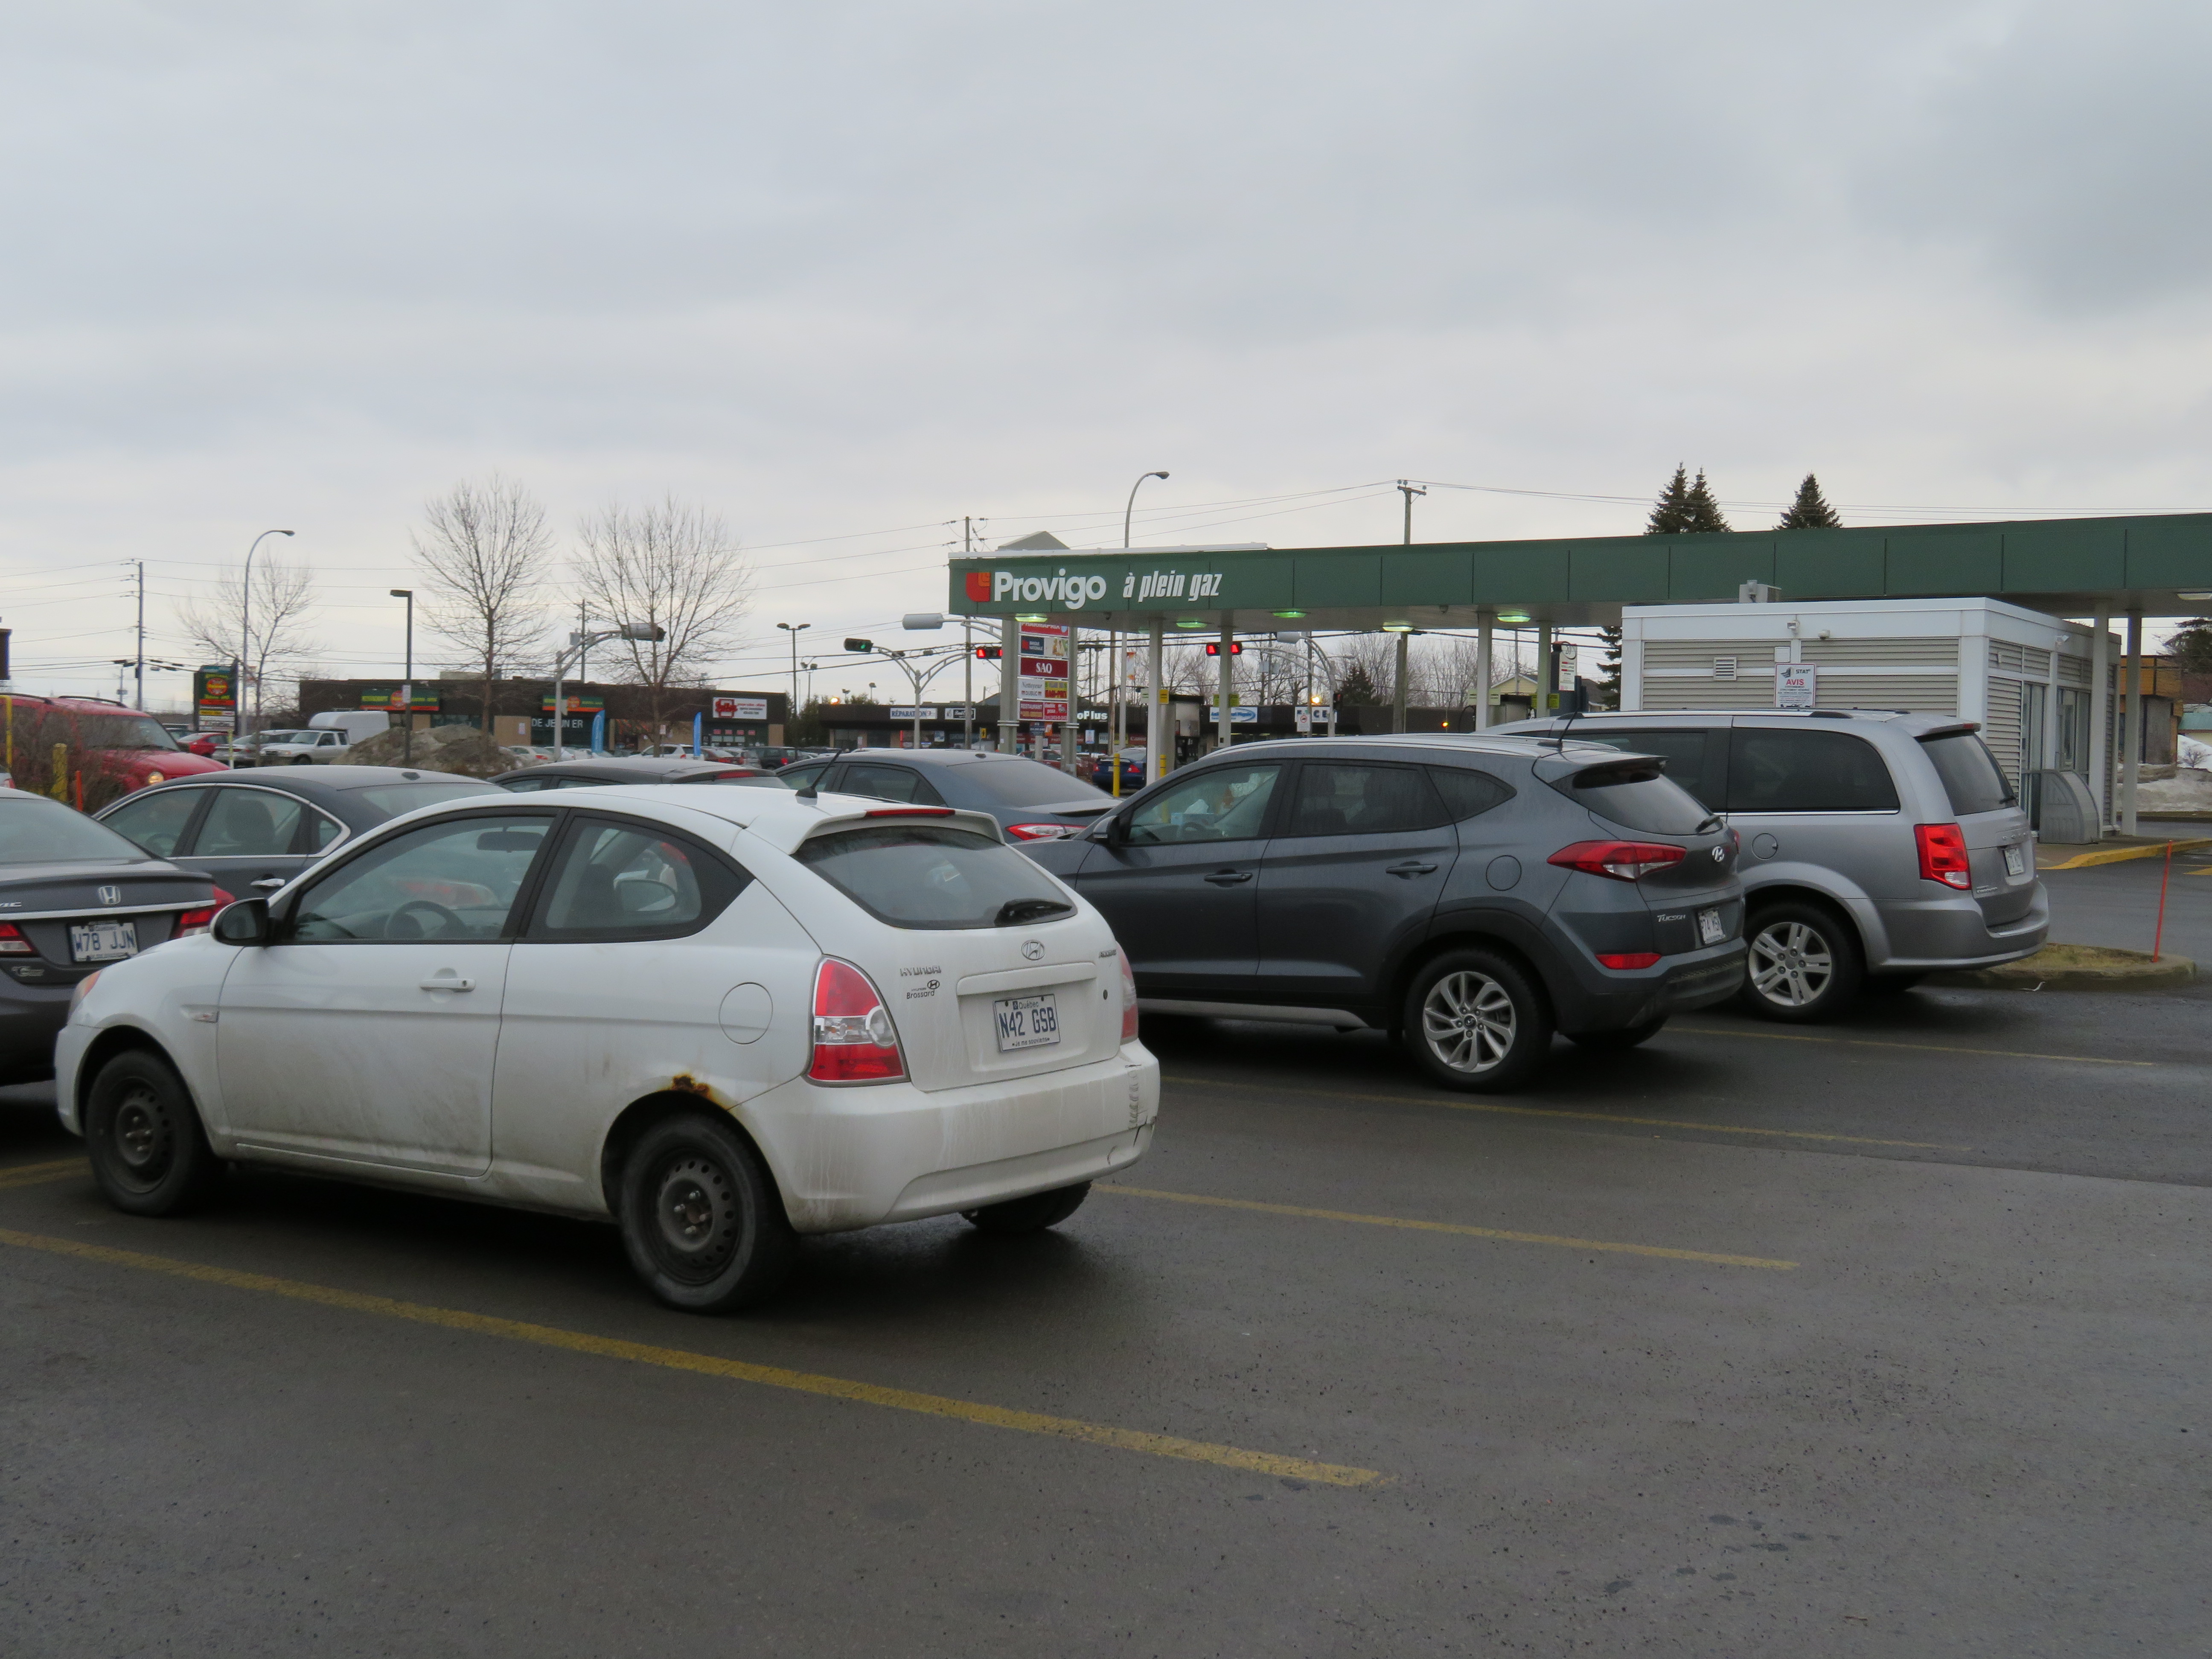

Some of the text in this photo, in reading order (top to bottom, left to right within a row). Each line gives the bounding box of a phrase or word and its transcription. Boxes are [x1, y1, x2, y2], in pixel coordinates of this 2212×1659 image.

[994, 568, 1106, 610] Provigo
[1123, 570, 1222, 602] à plein gaz
[1036, 662, 1053, 674] SAQ
[900, 966, 942, 976] HYUNDAI
[906, 990, 935, 999] Brossard
[1019, 1001, 1039, 1010] Québec
[999, 1006, 1057, 1039] N42 GSB
